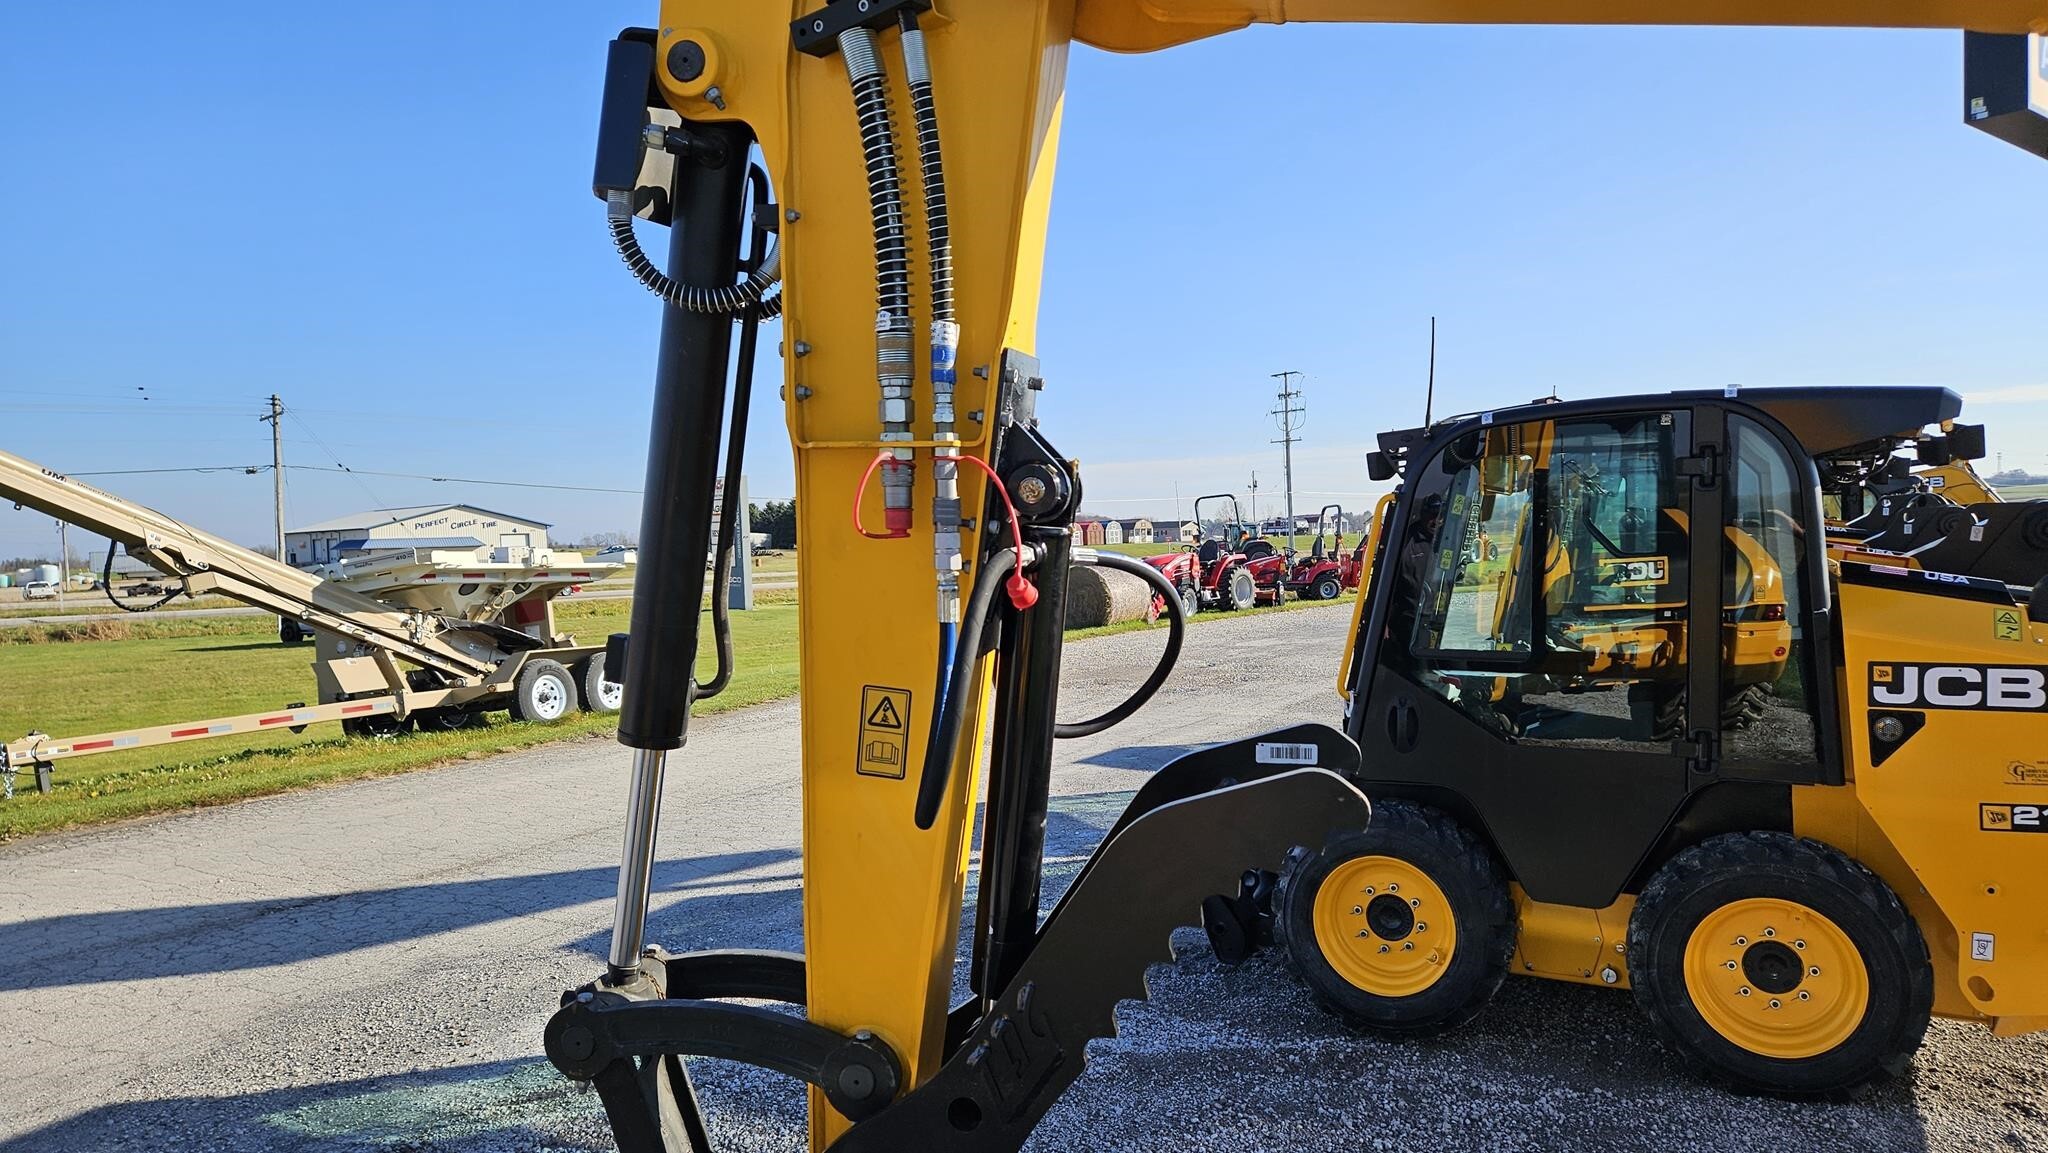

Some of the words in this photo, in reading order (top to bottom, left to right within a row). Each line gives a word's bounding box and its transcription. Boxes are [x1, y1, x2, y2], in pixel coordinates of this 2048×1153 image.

[414, 517, 448, 530] PERFECT
[450, 519, 478, 530] CIRCLE
[481, 521, 497, 529] TIRE
[1866, 548, 1894, 556] USA
[1924, 571, 1970, 585] USA
[1873, 666, 2047, 708] JCB
